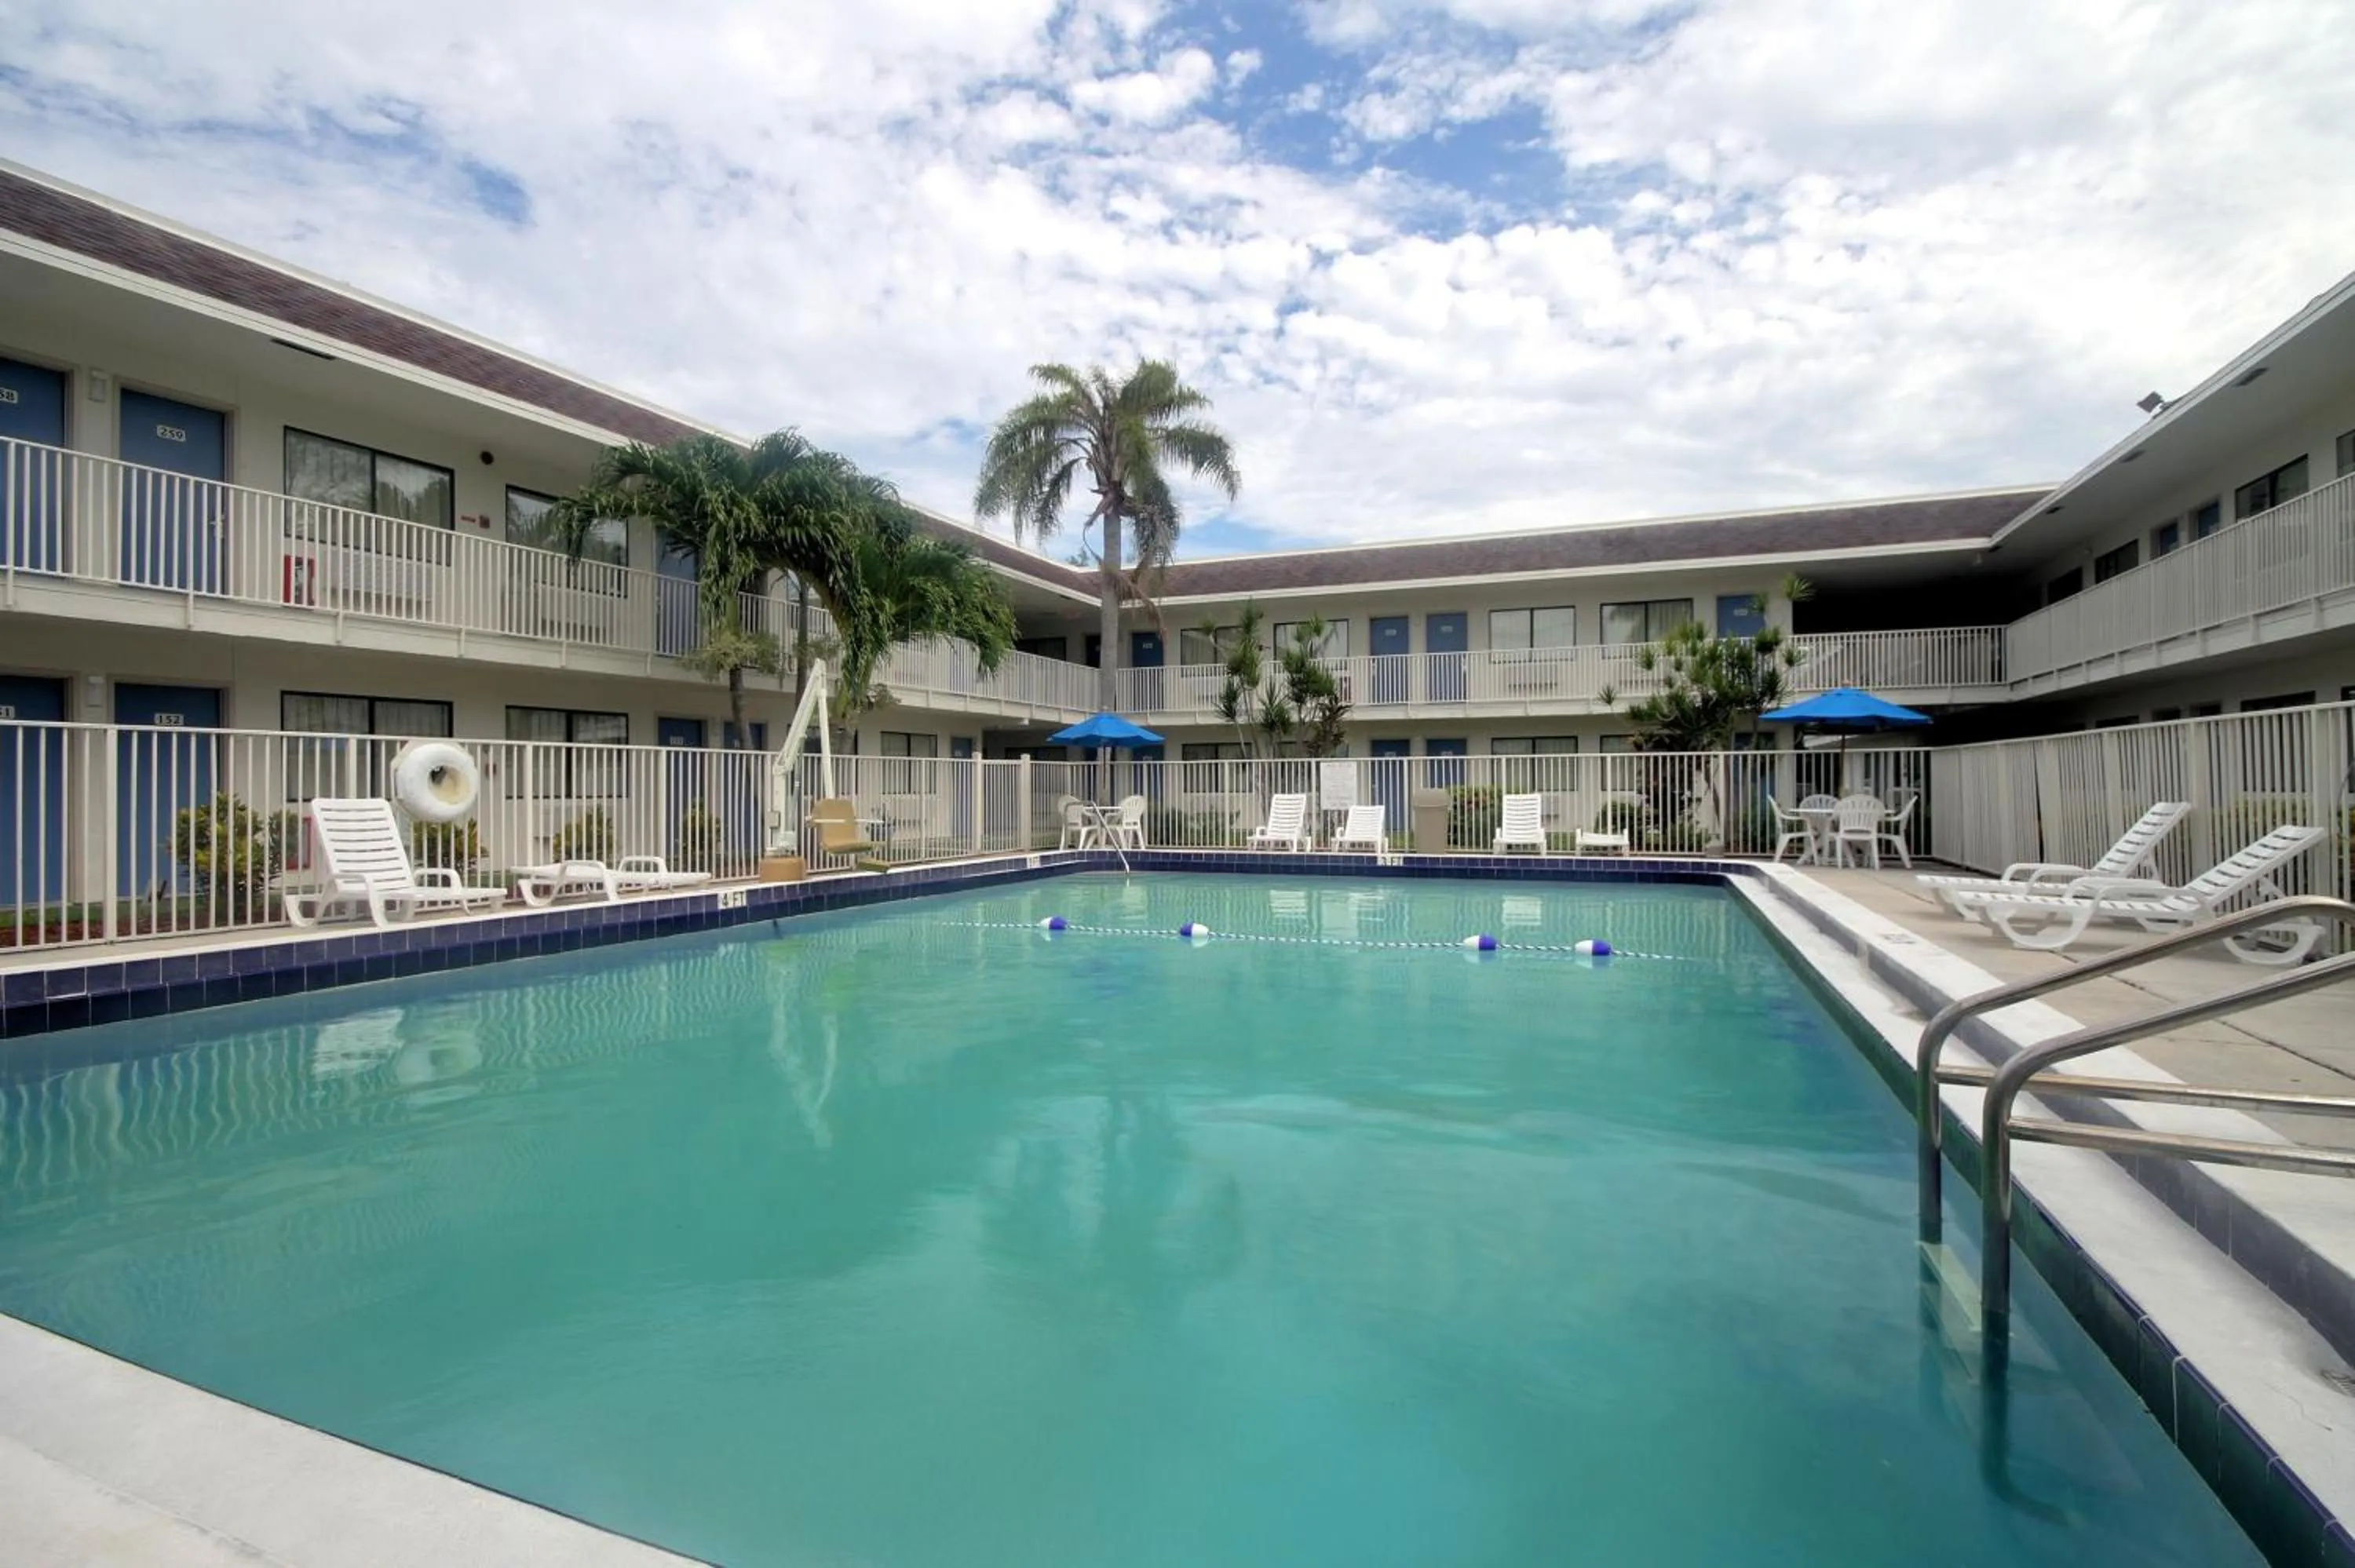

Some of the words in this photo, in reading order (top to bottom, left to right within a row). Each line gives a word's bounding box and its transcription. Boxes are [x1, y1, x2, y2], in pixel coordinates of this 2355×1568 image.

[159, 715, 181, 724] 152
[721, 892, 729, 906] 4
[732, 891, 745, 905] FT
